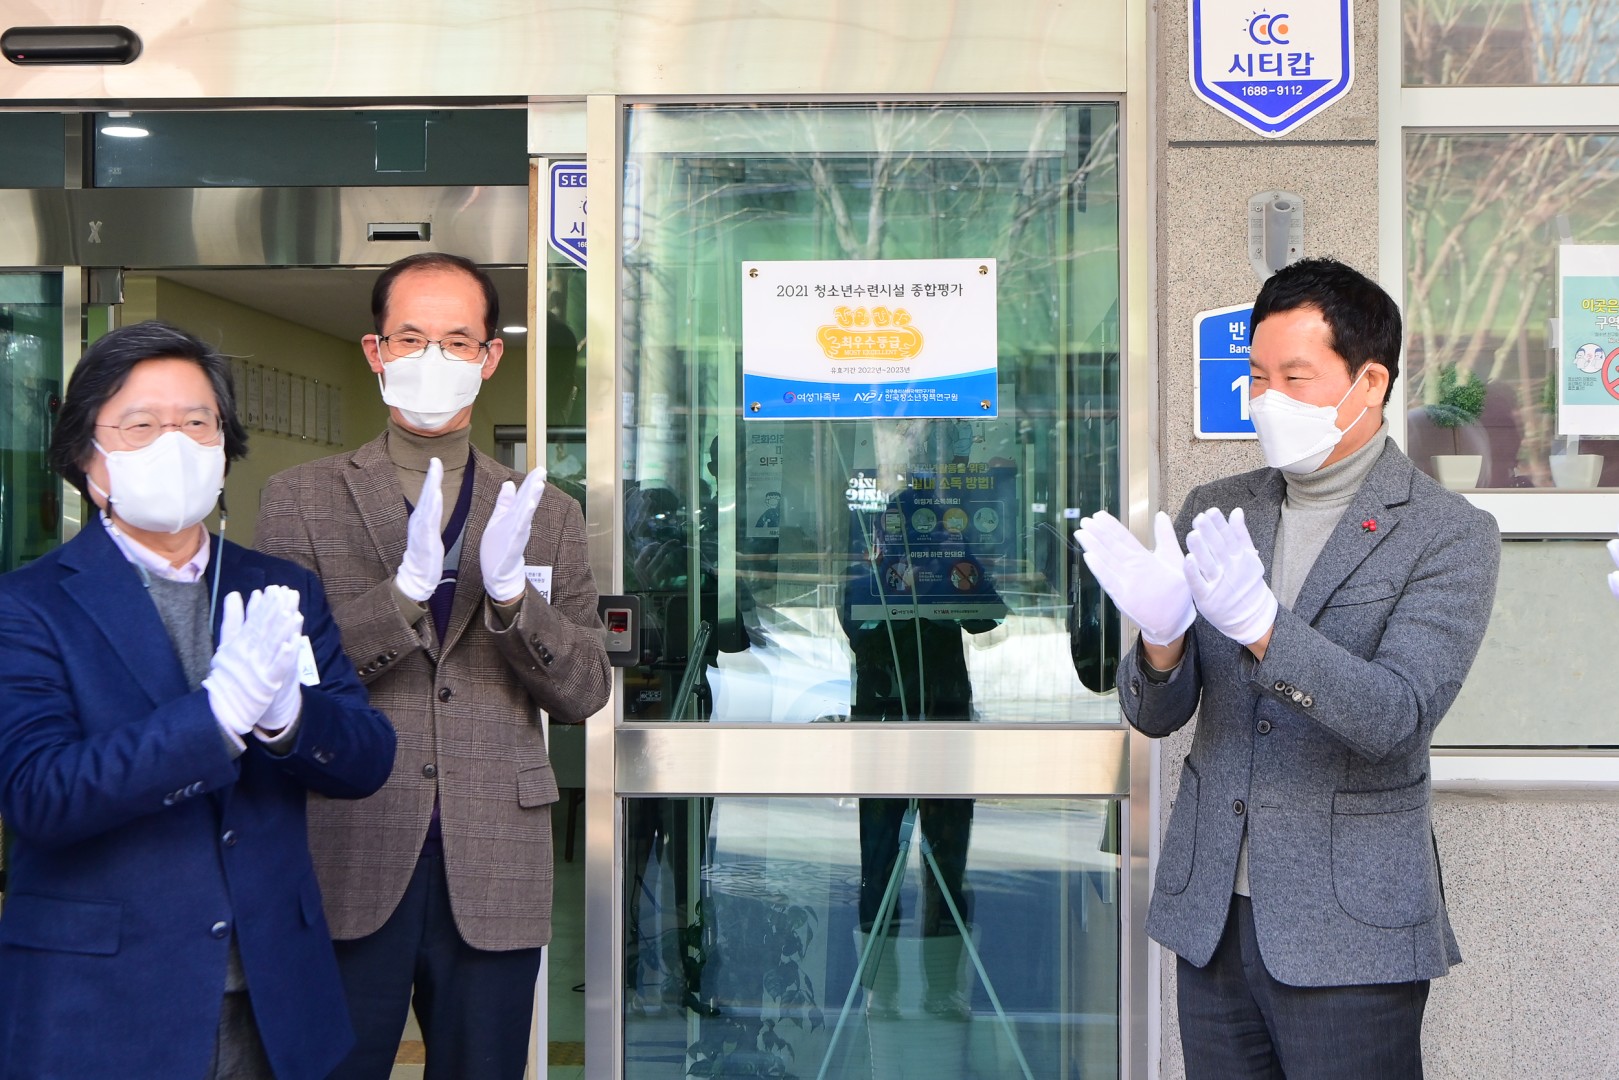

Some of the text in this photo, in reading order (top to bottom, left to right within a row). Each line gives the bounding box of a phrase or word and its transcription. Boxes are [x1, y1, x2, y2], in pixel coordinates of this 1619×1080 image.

[1228, 52, 1315, 77] 시티캅
[1241, 85, 1303, 96] 1688-9112
[776, 283, 963, 298] 2021 청소년수련시설 종합평가
[841, 335, 901, 349] 최우수등급
[830, 366, 910, 374] 유효기간 2022년~2023년
[797, 391, 841, 402] 여성가족부
